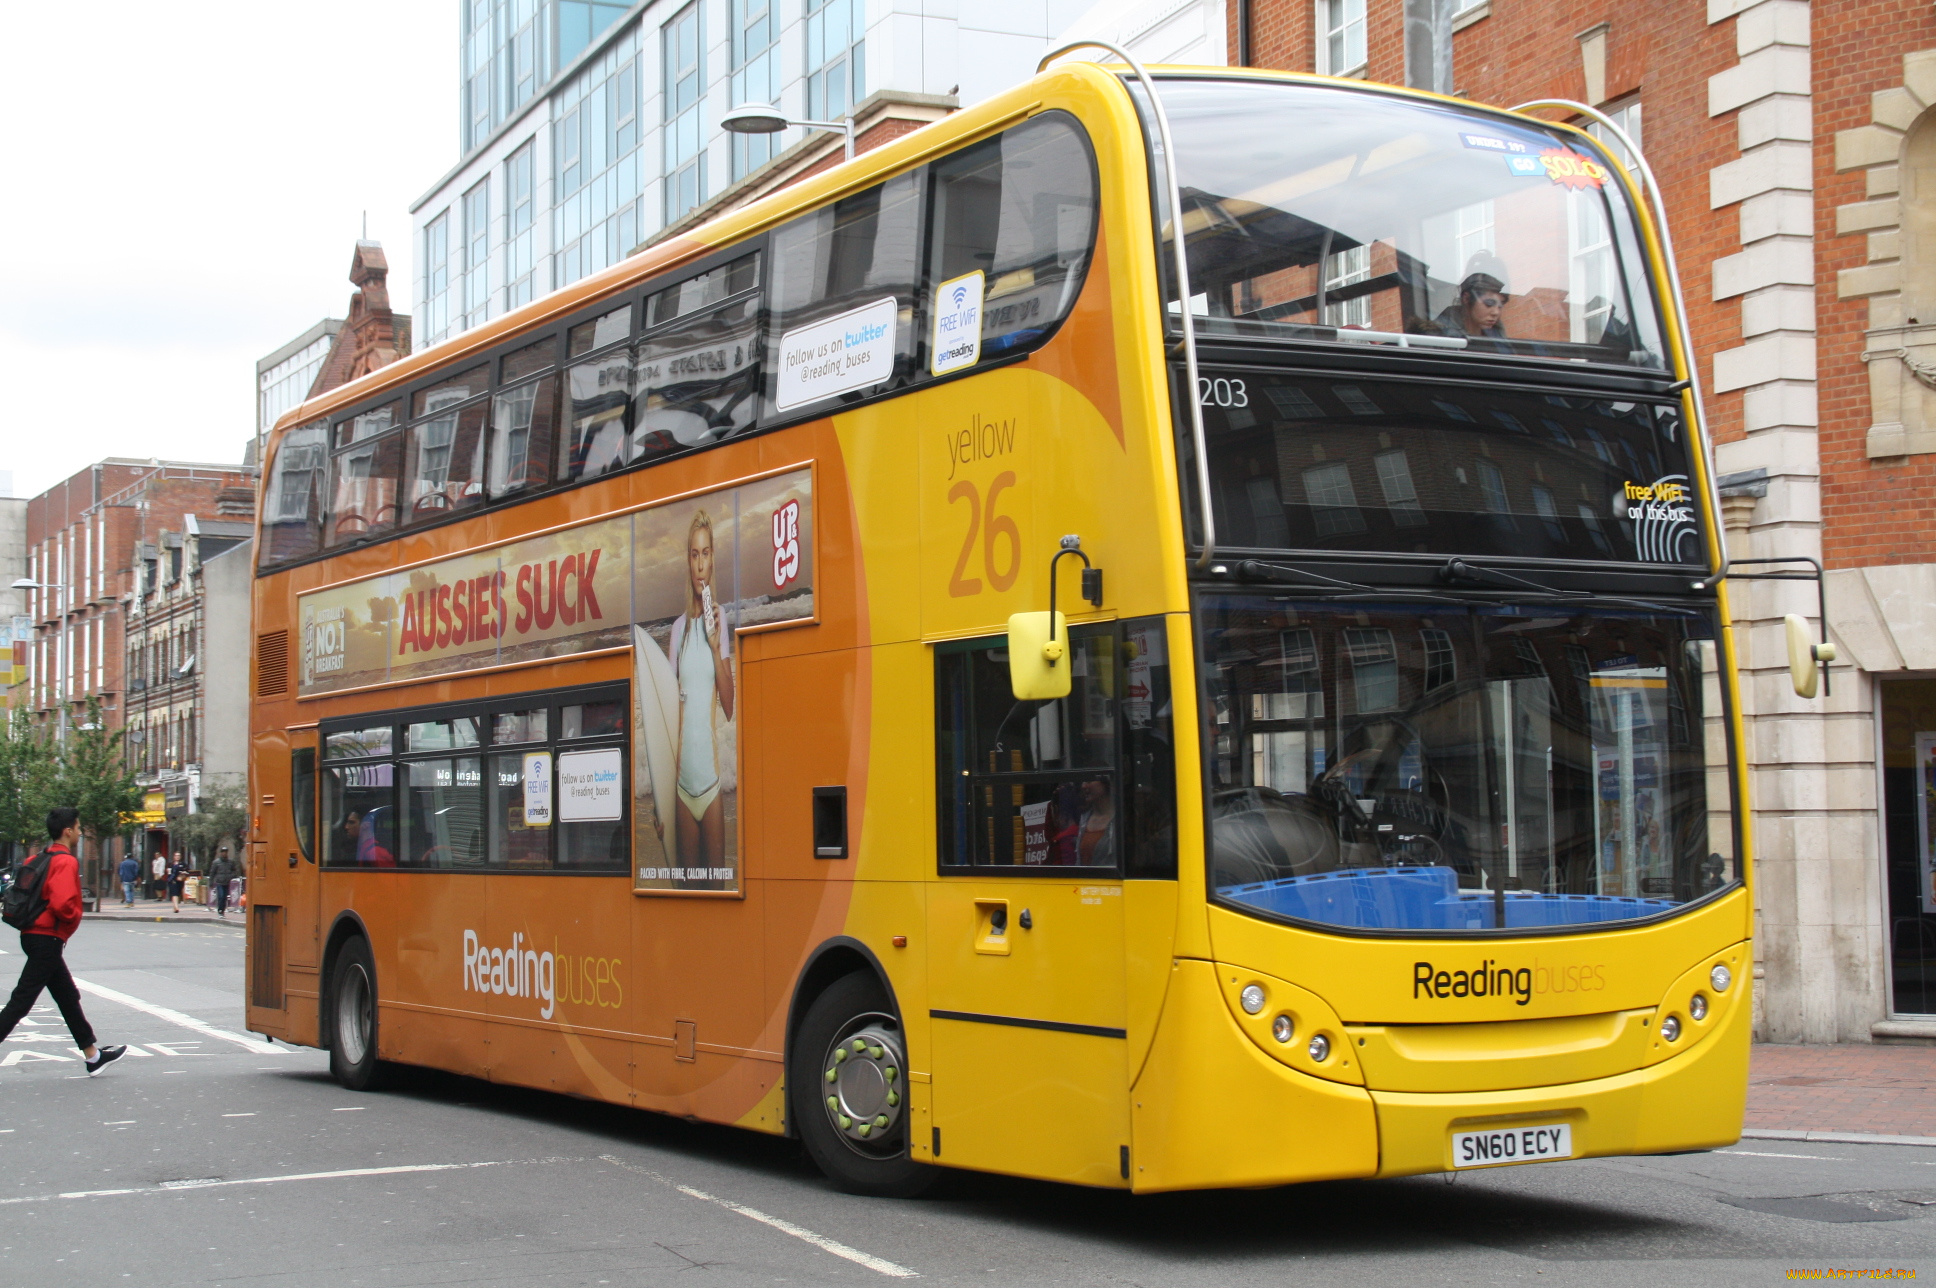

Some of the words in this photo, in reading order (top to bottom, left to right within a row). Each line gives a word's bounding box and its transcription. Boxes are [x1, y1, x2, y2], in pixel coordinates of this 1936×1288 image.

[1465, 135, 1506, 150] UNDER
[1512, 157, 1536, 172] GO
[1538, 155, 1609, 182] SOLO!
[939, 313, 958, 335] FREE
[786, 347, 815, 372] follow
[817, 343, 829, 358] us
[830, 338, 843, 354] on
[844, 322, 887, 349] twitter
[938, 342, 974, 365] getreading
[800, 350, 871, 383] @reading_buses
[1198, 377, 1249, 407] 203
[947, 413, 1016, 481] yellow
[1624, 481, 1653, 501] free
[1628, 507, 1643, 519] on
[1646, 504, 1666, 520] this
[1667, 505, 1688, 521] bus
[774, 502, 798, 548] UP
[947, 470, 1021, 598] 26
[774, 539, 798, 586] GO
[398, 570, 508, 655] AUSSIES
[515, 548, 603, 634] SUCK
[315, 621, 345, 656] NO.1
[315, 654, 345, 673] BREAKFAST
[498, 771, 518, 783] oad
[528, 780, 538, 793] FREE
[561, 772, 578, 788] follow
[580, 775, 587, 783] us
[587, 774, 594, 783] on
[595, 770, 618, 783] twitter
[571, 786, 610, 801] @reading_buses
[528, 805, 548, 818] getreading
[640, 867, 657, 880] PACKED
[658, 867, 670, 880] WITH
[671, 867, 686, 881] FIBRE,
[687, 867, 707, 880] CALCIUM
[713, 867, 734, 880] PROTEIN
[1461, 1133, 1516, 1161] SN60
[1522, 1128, 1561, 1156] ECY
